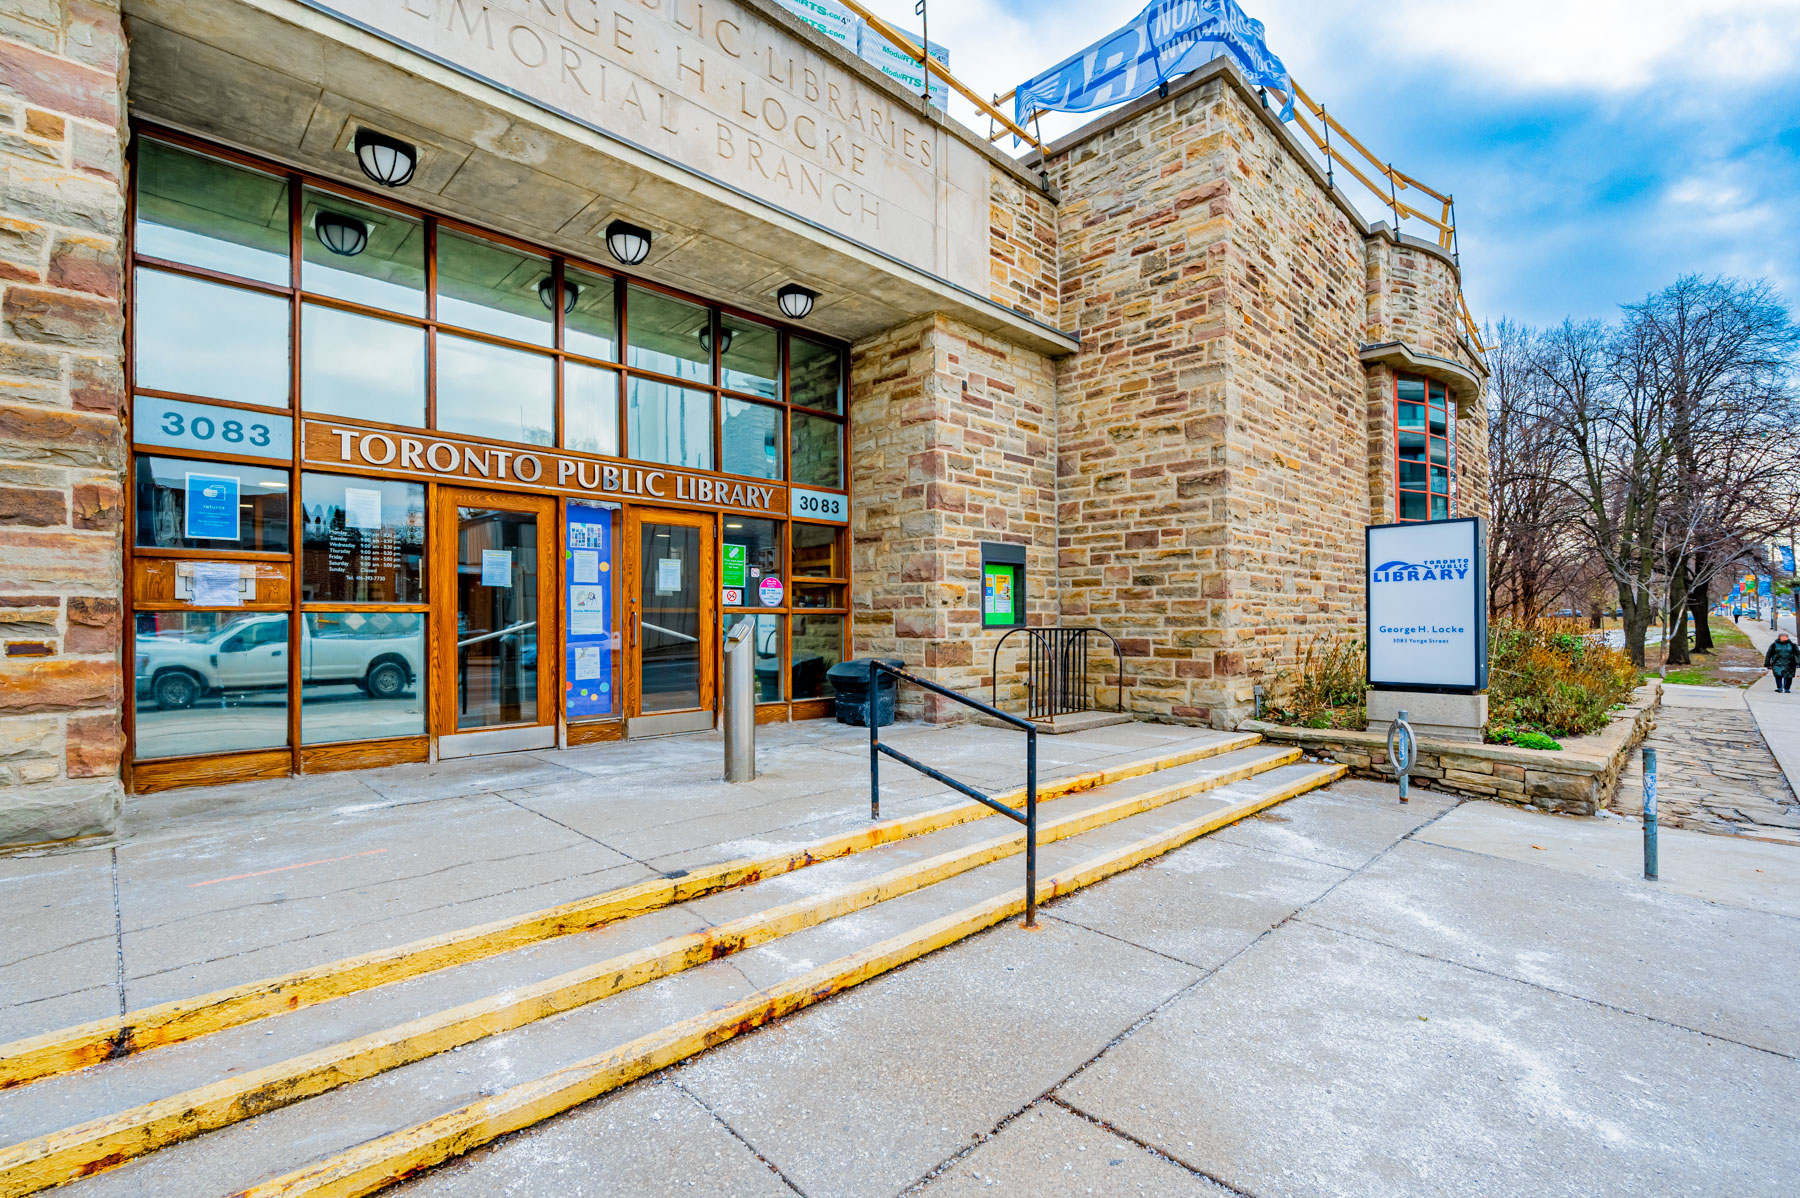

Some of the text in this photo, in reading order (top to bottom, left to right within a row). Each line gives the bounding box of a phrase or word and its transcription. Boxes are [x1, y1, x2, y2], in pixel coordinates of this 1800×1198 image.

[677, 45, 705, 93] H
[740, 81, 866, 175] LOCKE
[768, 45, 932, 167] LIBRARIES
[716, 121, 881, 230] BRANCH
[161, 411, 271, 447] 3083
[332, 428, 774, 509] TORONTO PUBLIC LIBRARY
[800, 495, 840, 514] 3083
[1373, 568, 1469, 583] LIBRARY
[1379, 625, 1465, 635] George H. Locke
